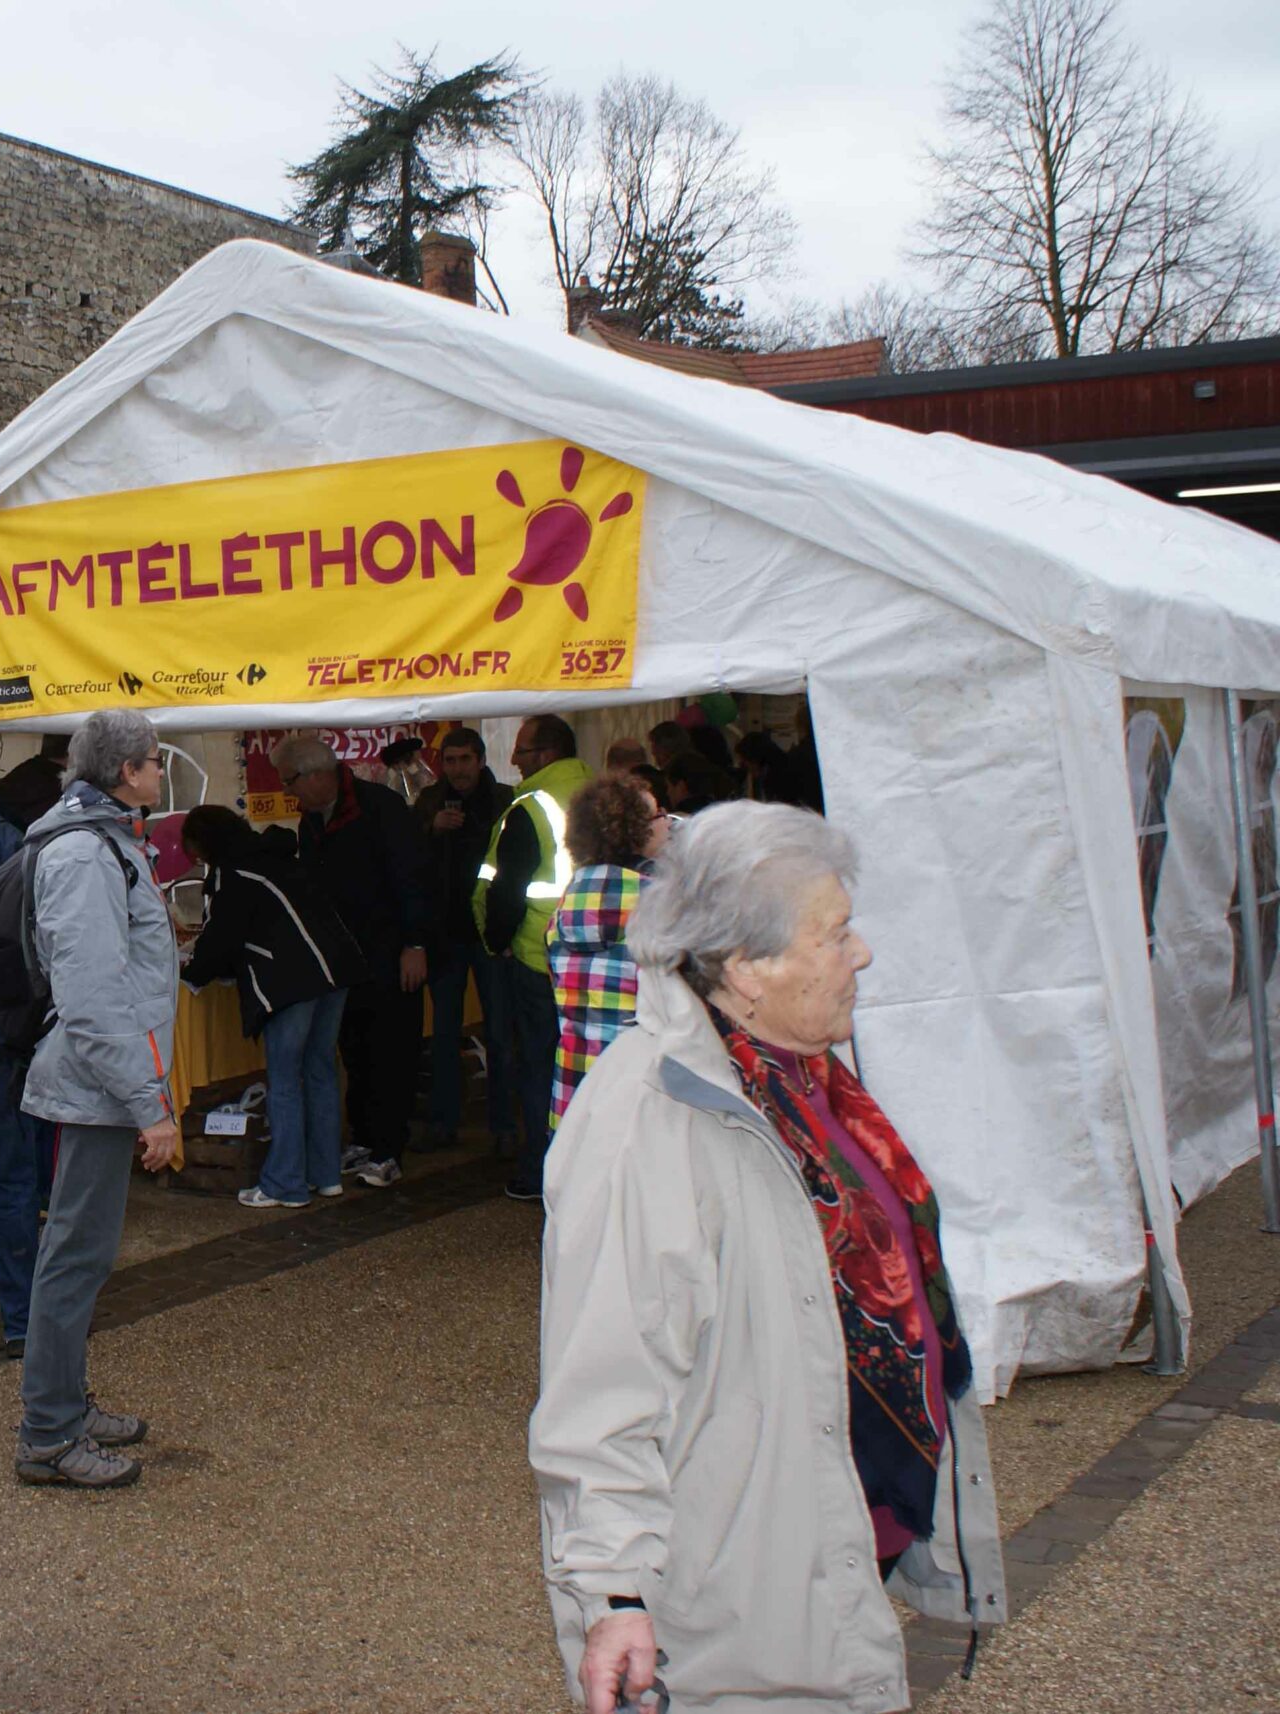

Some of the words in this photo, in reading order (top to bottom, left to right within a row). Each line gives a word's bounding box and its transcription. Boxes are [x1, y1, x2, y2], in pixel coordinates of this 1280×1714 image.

[26, 664, 37, 672] DE
[307, 651, 511, 687] TELETHON.FR
[560, 648, 626, 675] 3637
[152, 668, 229, 684] Carrefour
[45, 680, 113, 697] Carrefour
[176, 684, 225, 697] market
